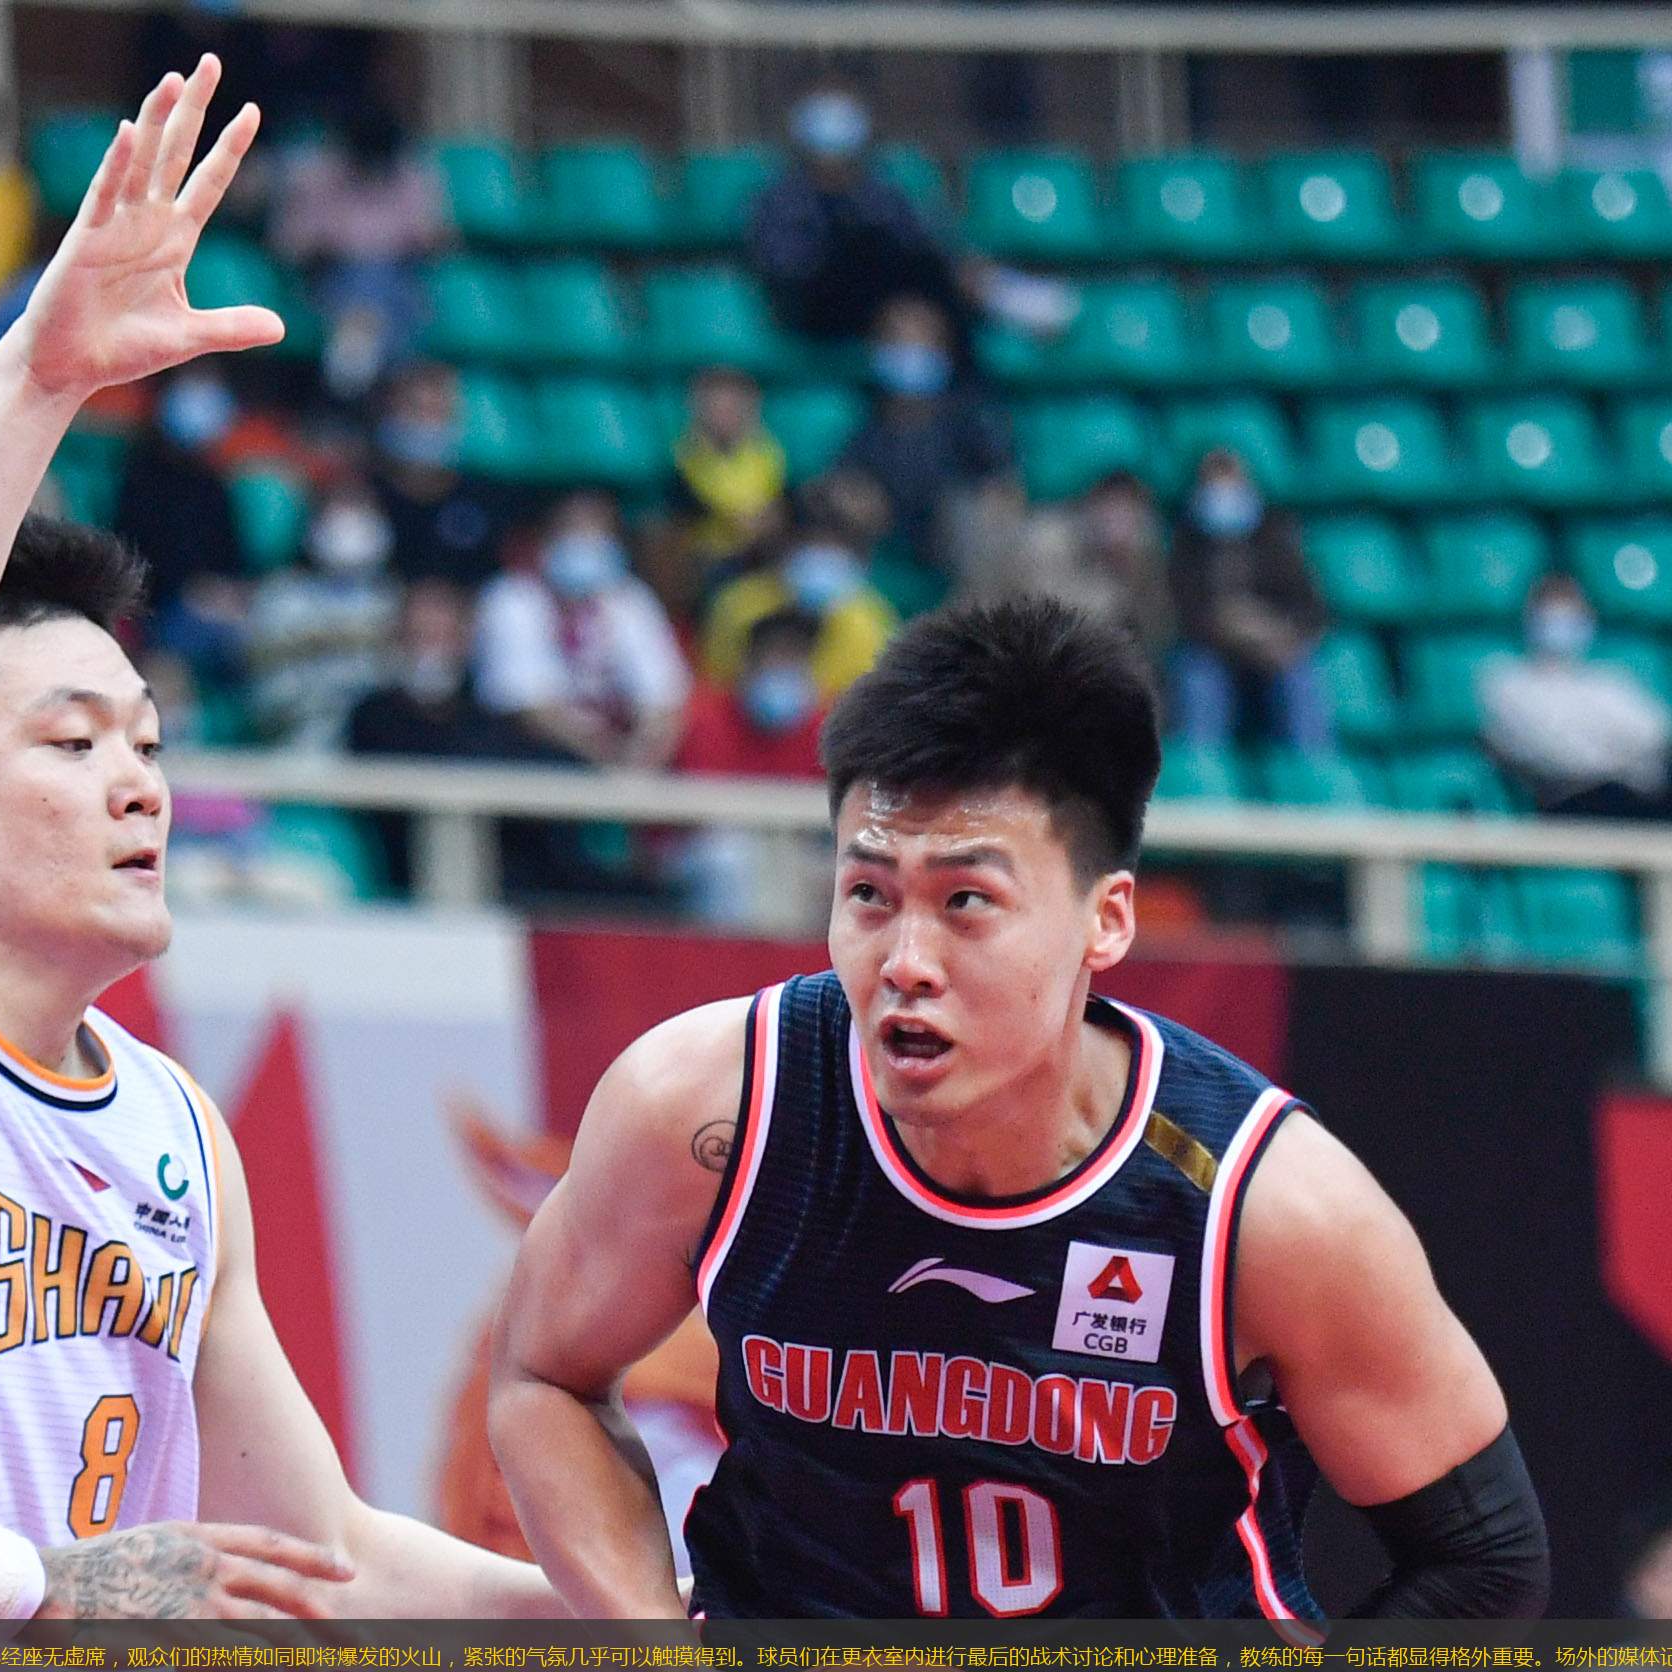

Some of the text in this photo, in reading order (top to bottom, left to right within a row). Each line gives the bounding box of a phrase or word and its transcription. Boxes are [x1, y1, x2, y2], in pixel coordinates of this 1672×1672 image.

[1072, 1311, 1147, 1335] 广发银行
[1083, 1333, 1128, 1354] CGB
[741, 1334, 1177, 1465] GUANGDONG
[67, 1394, 140, 1541] 8
[892, 1477, 1064, 1618] 10
